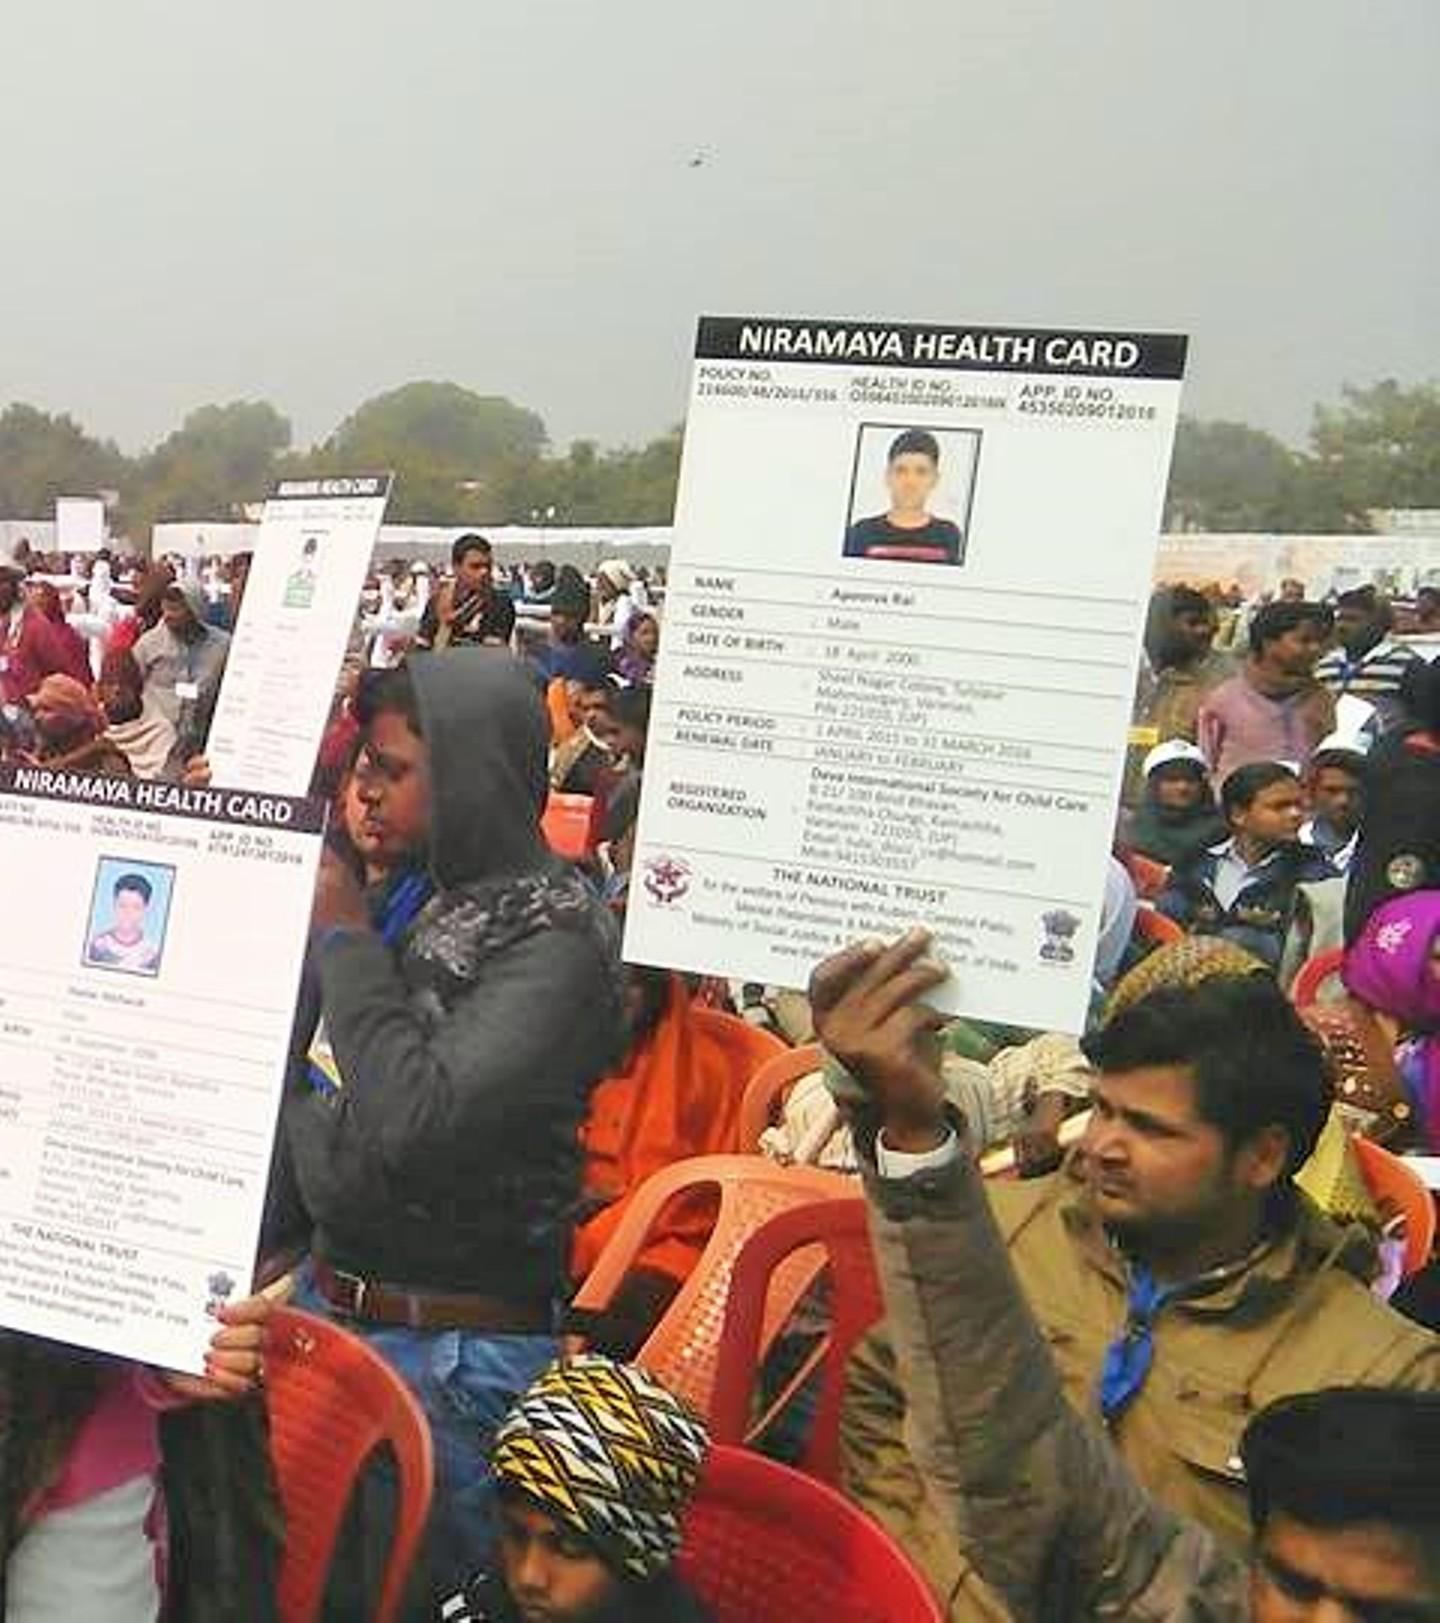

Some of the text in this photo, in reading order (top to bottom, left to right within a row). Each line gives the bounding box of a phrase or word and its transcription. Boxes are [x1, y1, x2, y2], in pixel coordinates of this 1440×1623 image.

[738, 325, 1141, 369] NIRAMAYA HEALTH CARD
[697, 365, 746, 382] POLICY
[849, 374, 909, 391] HEALTH
[693, 574, 735, 591] NAME
[689, 602, 745, 621] GENDER
[826, 615, 861, 631] Male
[685, 631, 720, 648] DATE
[743, 636, 785, 654] BIRTH
[681, 663, 744, 683] ADDRESS
[676, 708, 777, 730] POLICY PERIOD
[674, 729, 774, 752] RENEWAL DATE
[13, 768, 133, 803] NIRAMAYA
[134, 783, 223, 814] HEALTH
[668, 779, 747, 802] REGISTERED
[846, 770, 937, 795] International
[939, 781, 990, 801] Society
[990, 786, 1013, 803] for
[1014, 789, 1054, 808] Child
[666, 794, 768, 821] ORGANIZATION
[771, 867, 948, 904] THE NATIONAL TRUST
[34, 1227, 97, 1251] NATIONAL
[97, 1242, 140, 1261] TRUST
